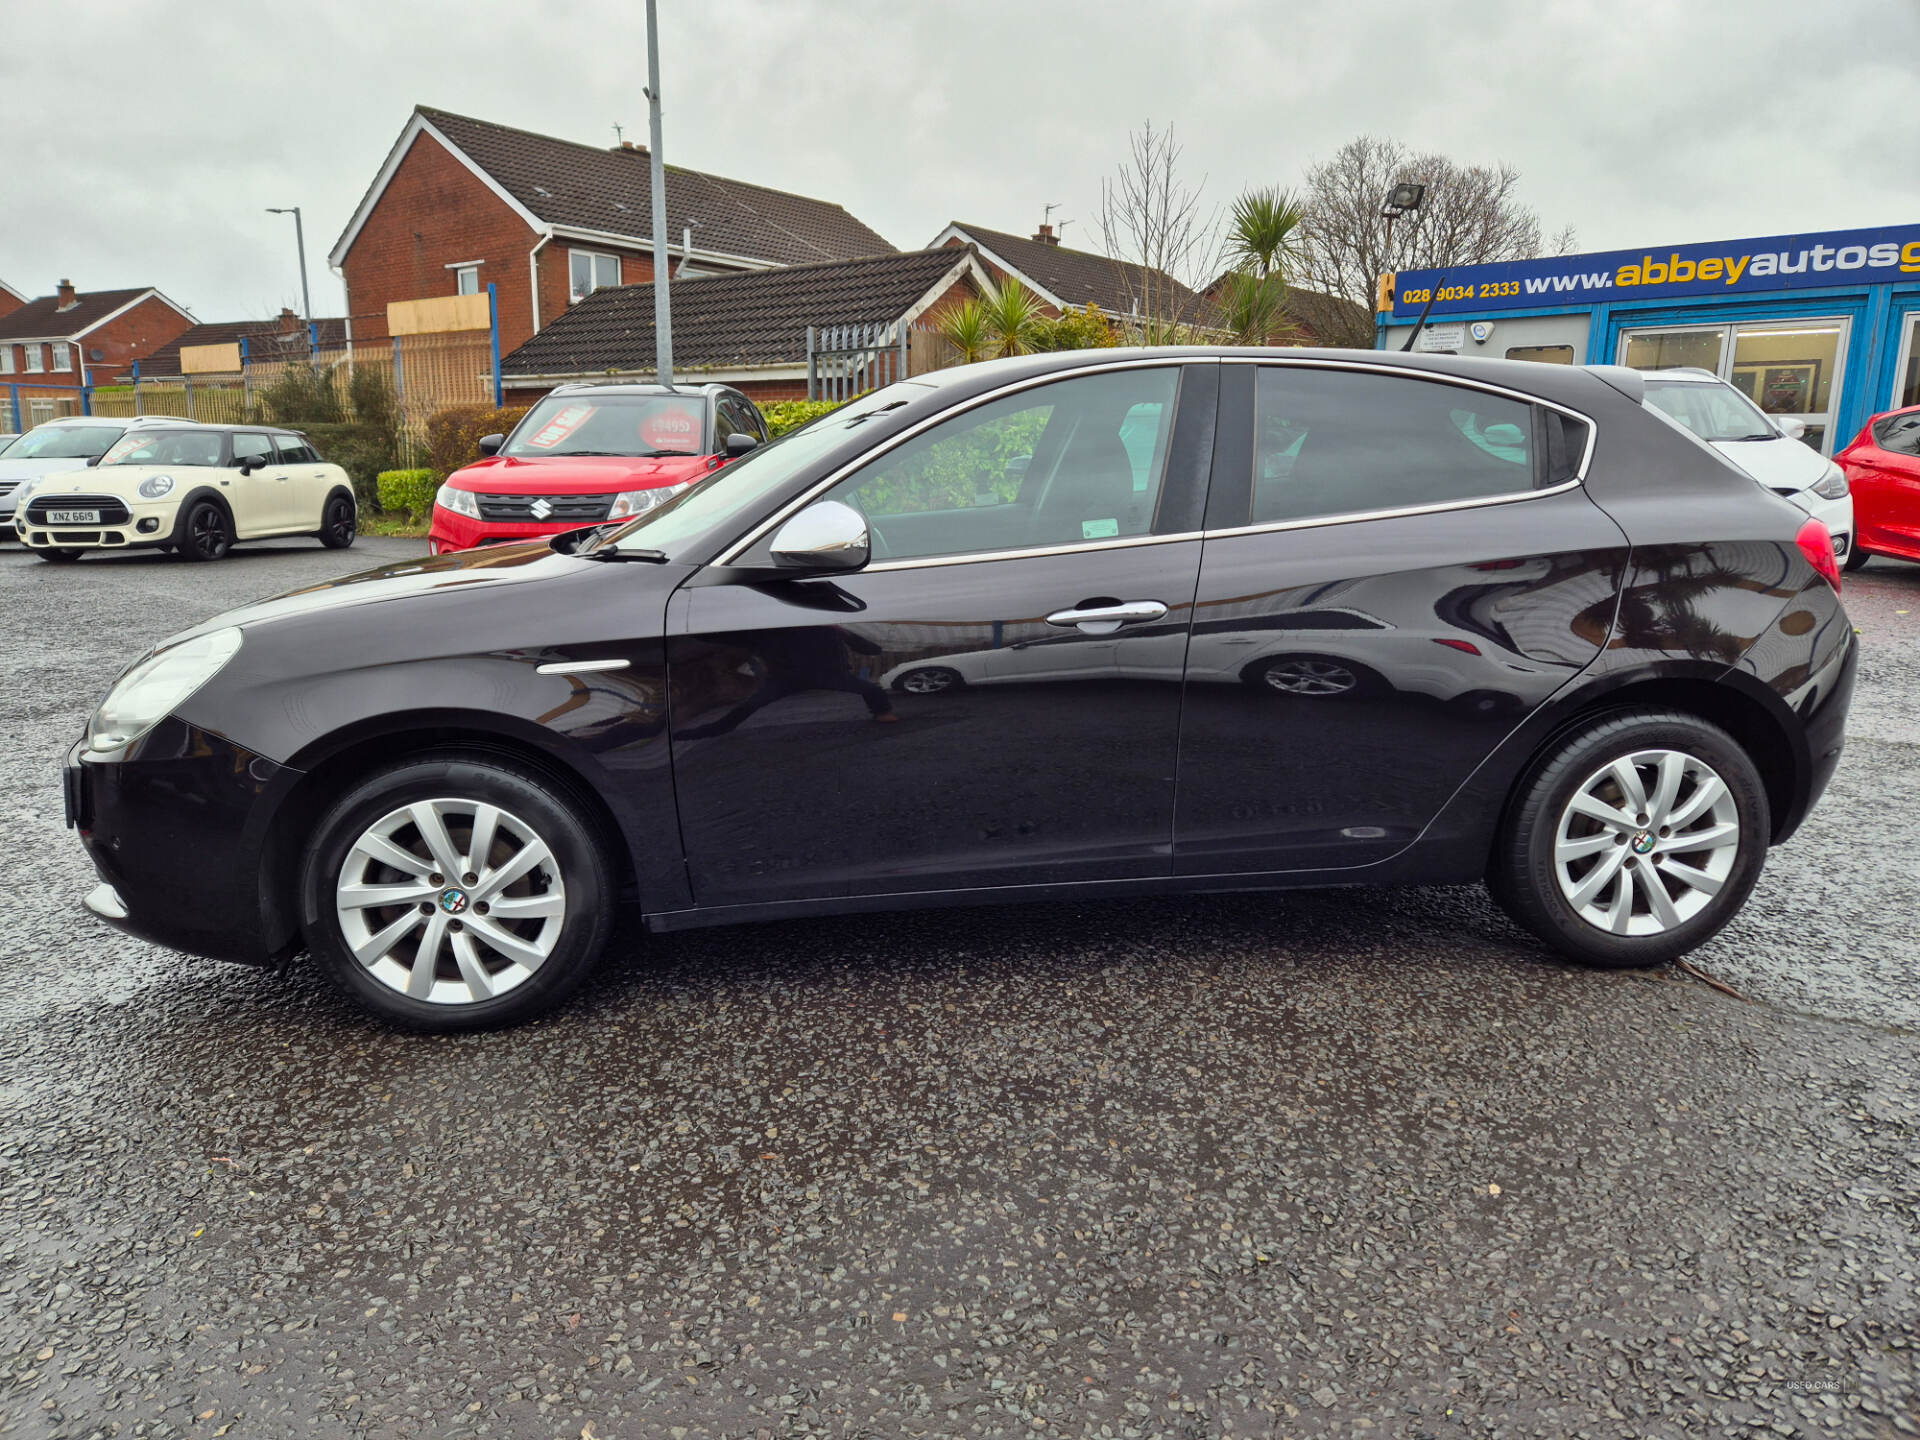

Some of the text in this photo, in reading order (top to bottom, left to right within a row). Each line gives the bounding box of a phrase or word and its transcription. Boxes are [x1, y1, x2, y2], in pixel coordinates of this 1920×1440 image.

[1403, 289, 1431, 304] 028
[1435, 284, 1475, 301] 9034
[1479, 281, 1520, 298] 2333
[52, 511, 94, 521] XNZ 6619
